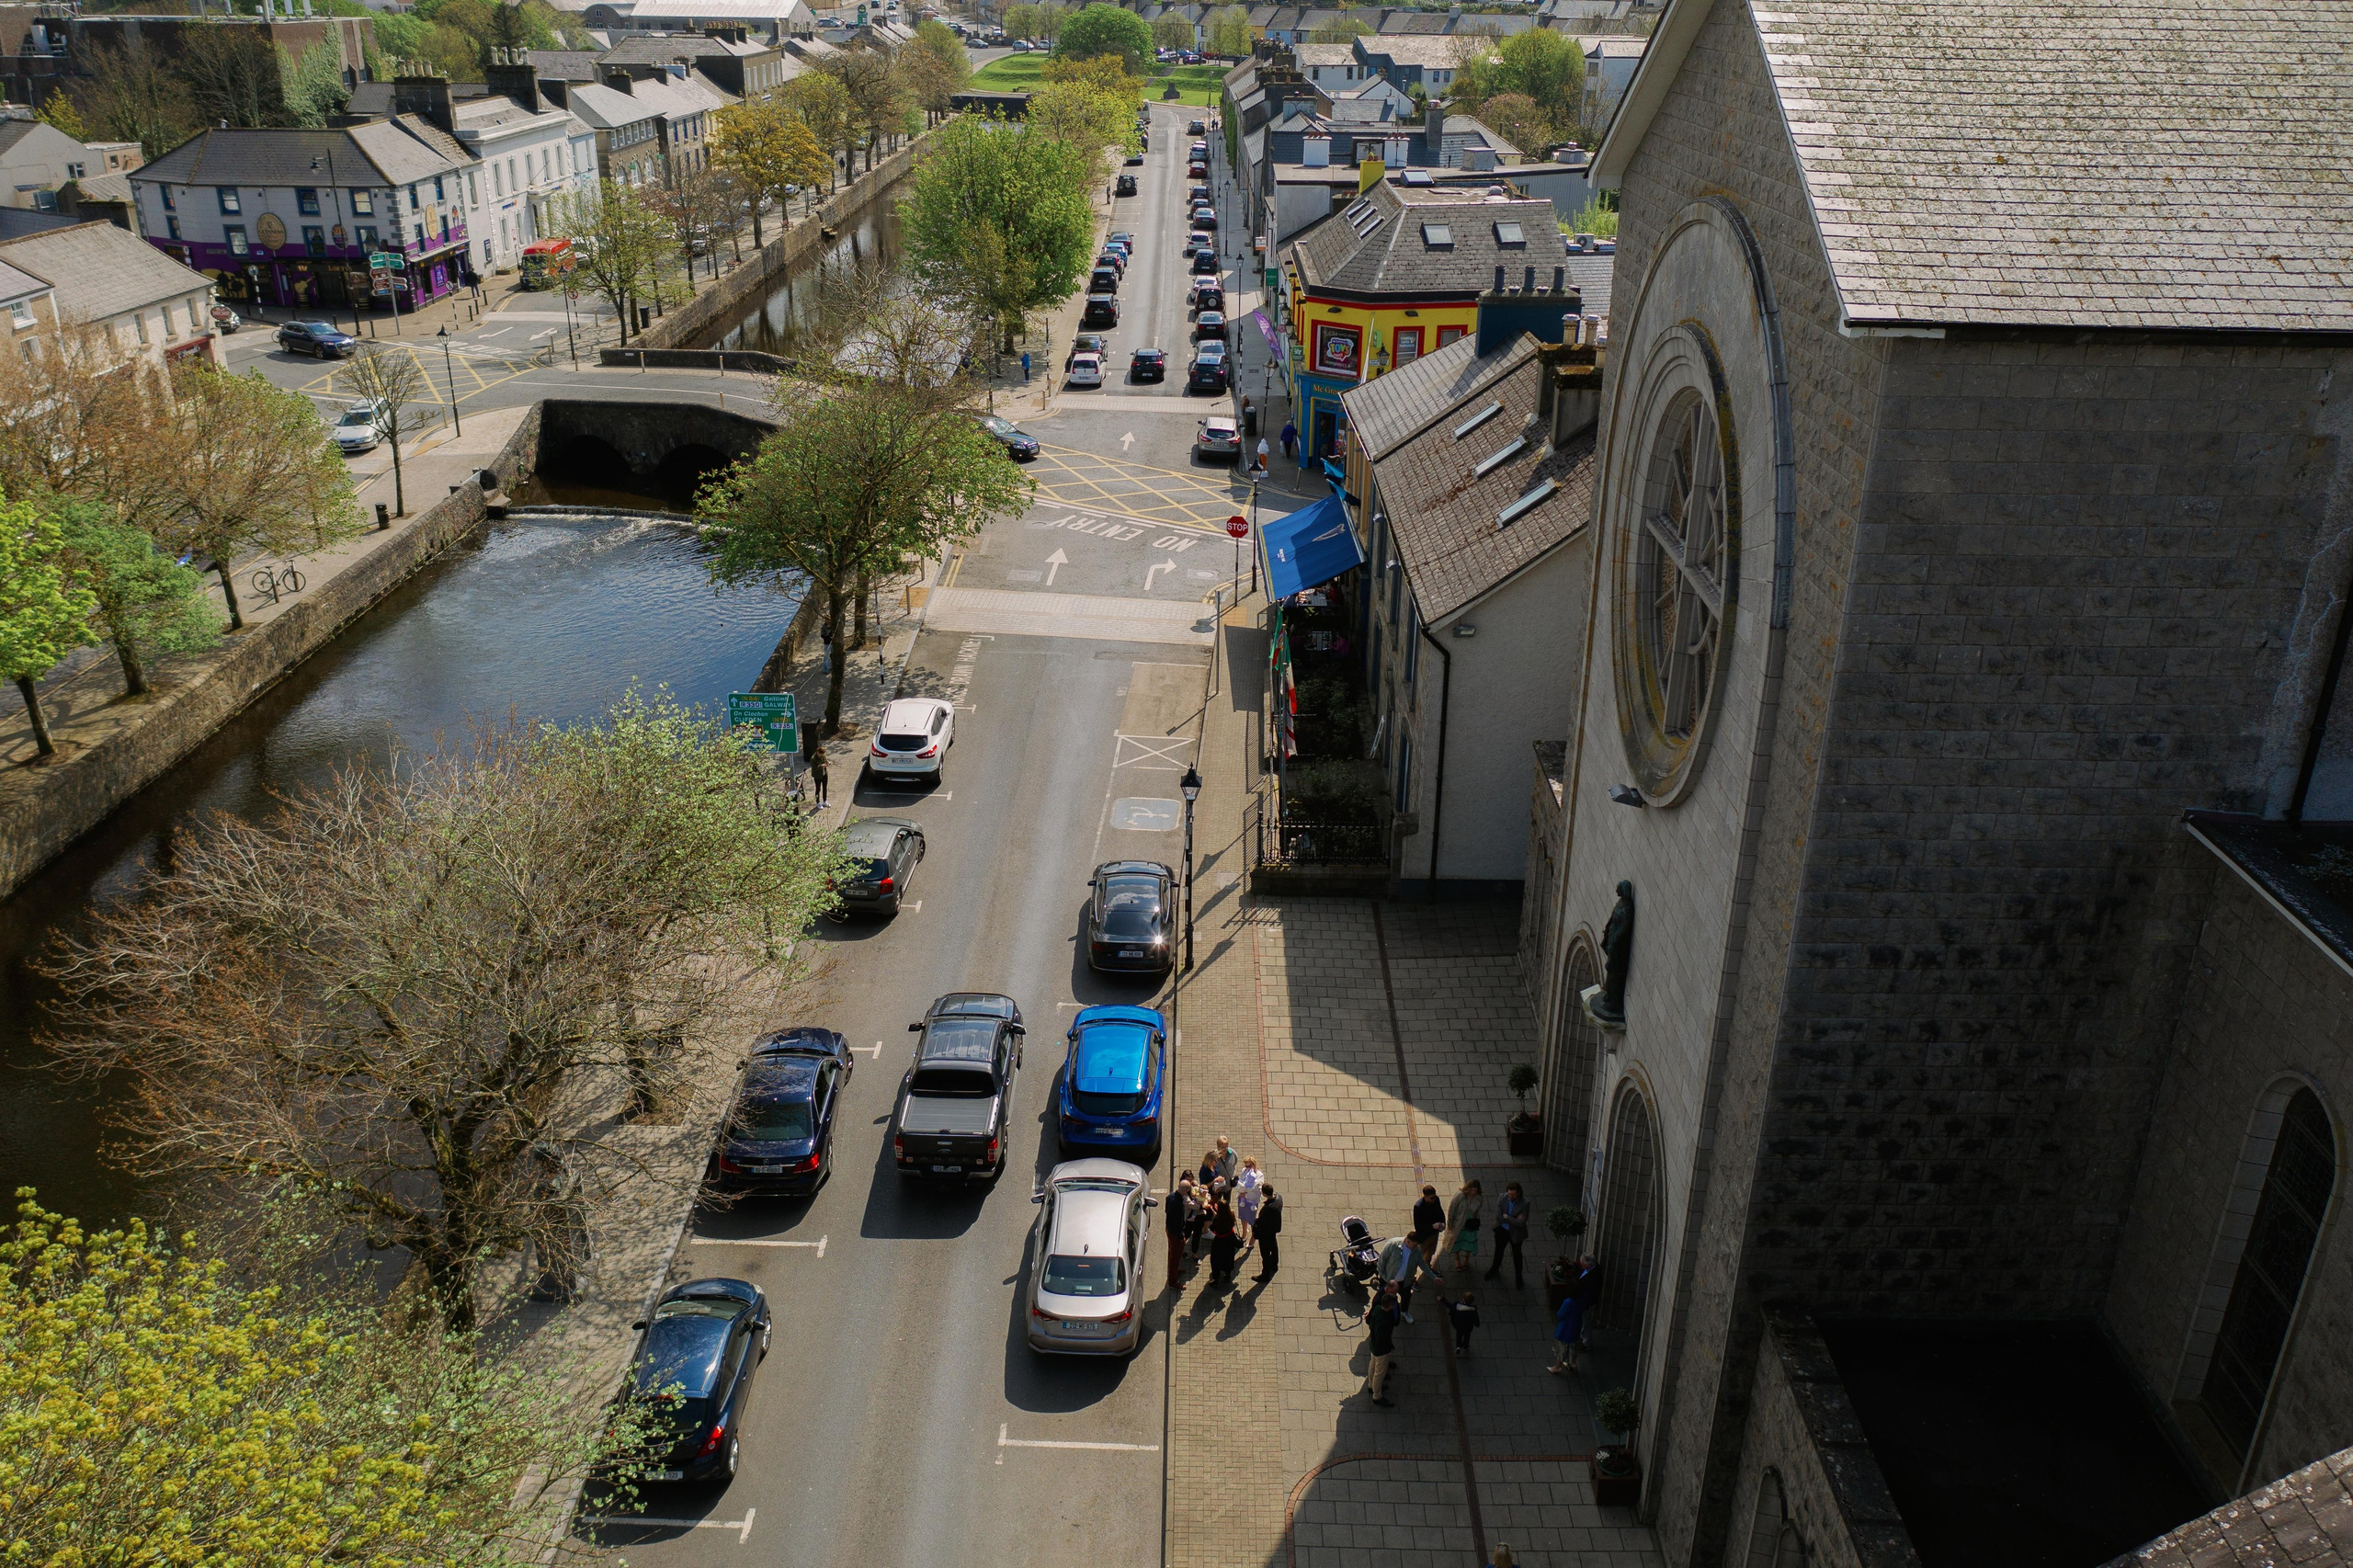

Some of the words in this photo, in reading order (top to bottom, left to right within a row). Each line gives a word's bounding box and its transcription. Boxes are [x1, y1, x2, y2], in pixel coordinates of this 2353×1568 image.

[1330, 343, 1349, 355] TOYS
[1050, 515, 1144, 541] ENTRY
[1227, 522, 1248, 531] STOP
[1153, 536, 1198, 552] NO
